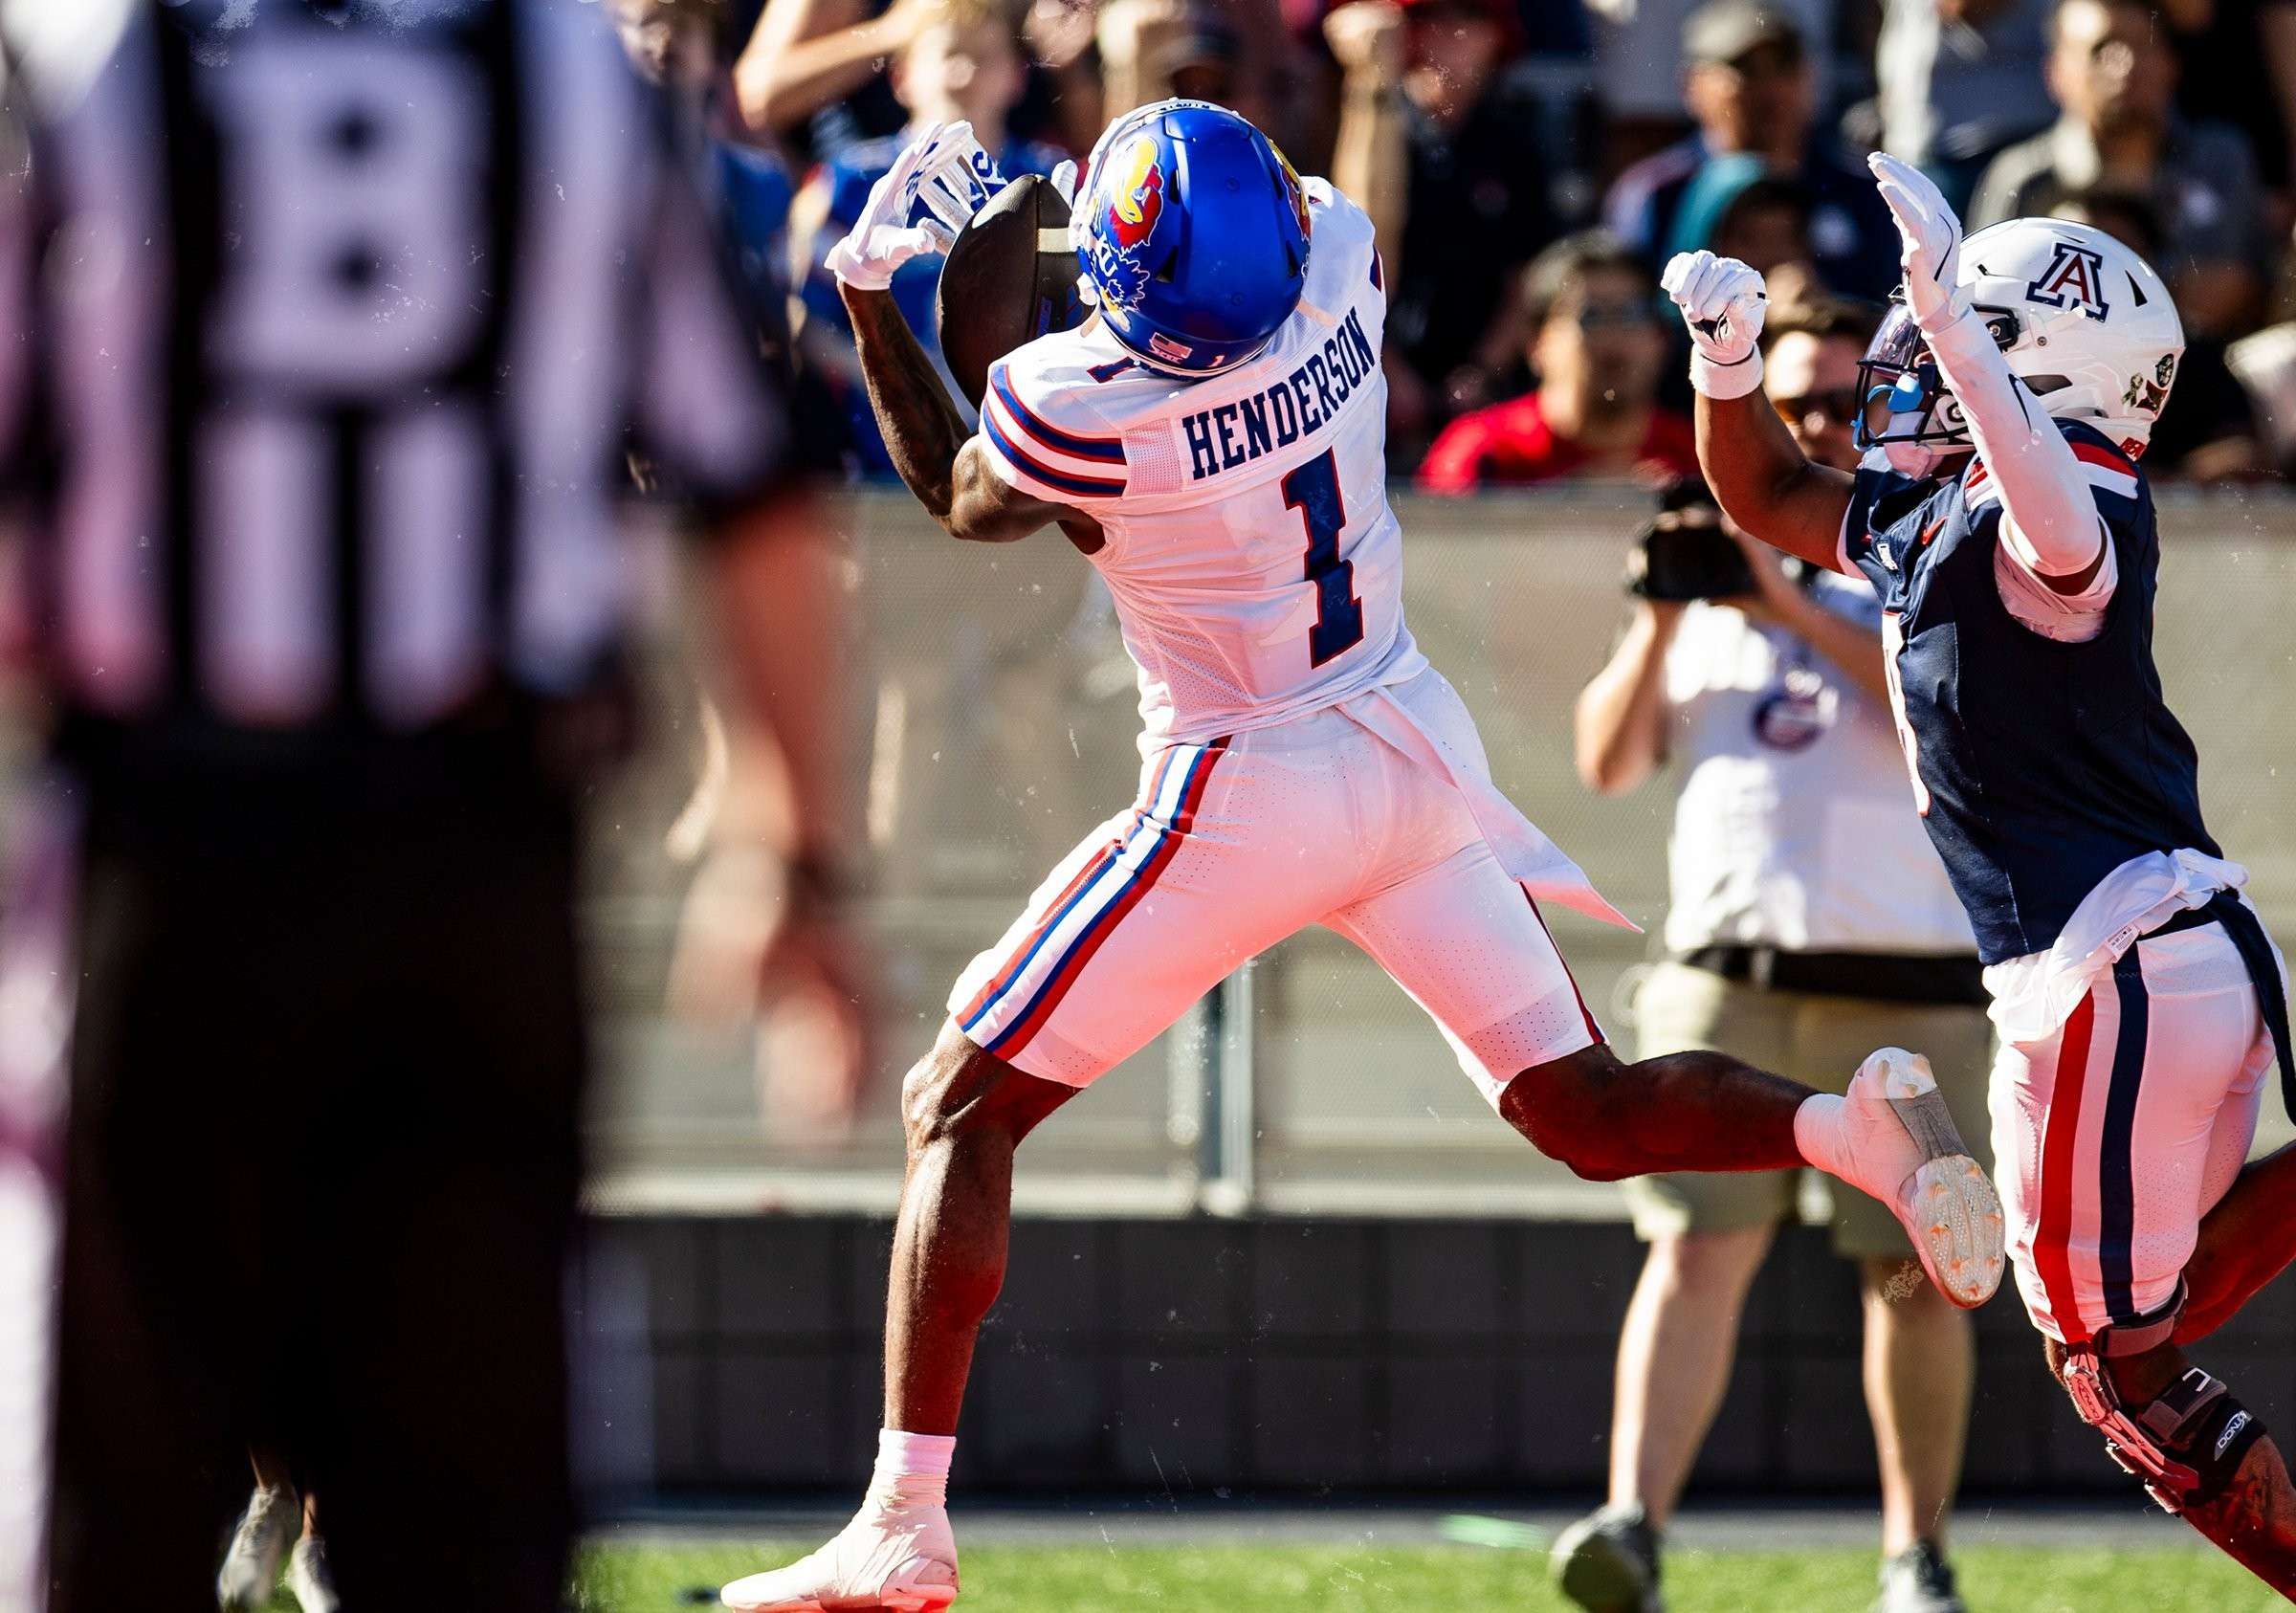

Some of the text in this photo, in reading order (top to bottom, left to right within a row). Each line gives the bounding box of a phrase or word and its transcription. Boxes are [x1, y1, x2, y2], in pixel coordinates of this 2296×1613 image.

[197, 34, 486, 381] B
[2025, 242, 2109, 322] A
[1182, 306, 1375, 480] HENDERSON
[1207, 354, 1225, 368] 1
[1280, 446, 1364, 669] 1
